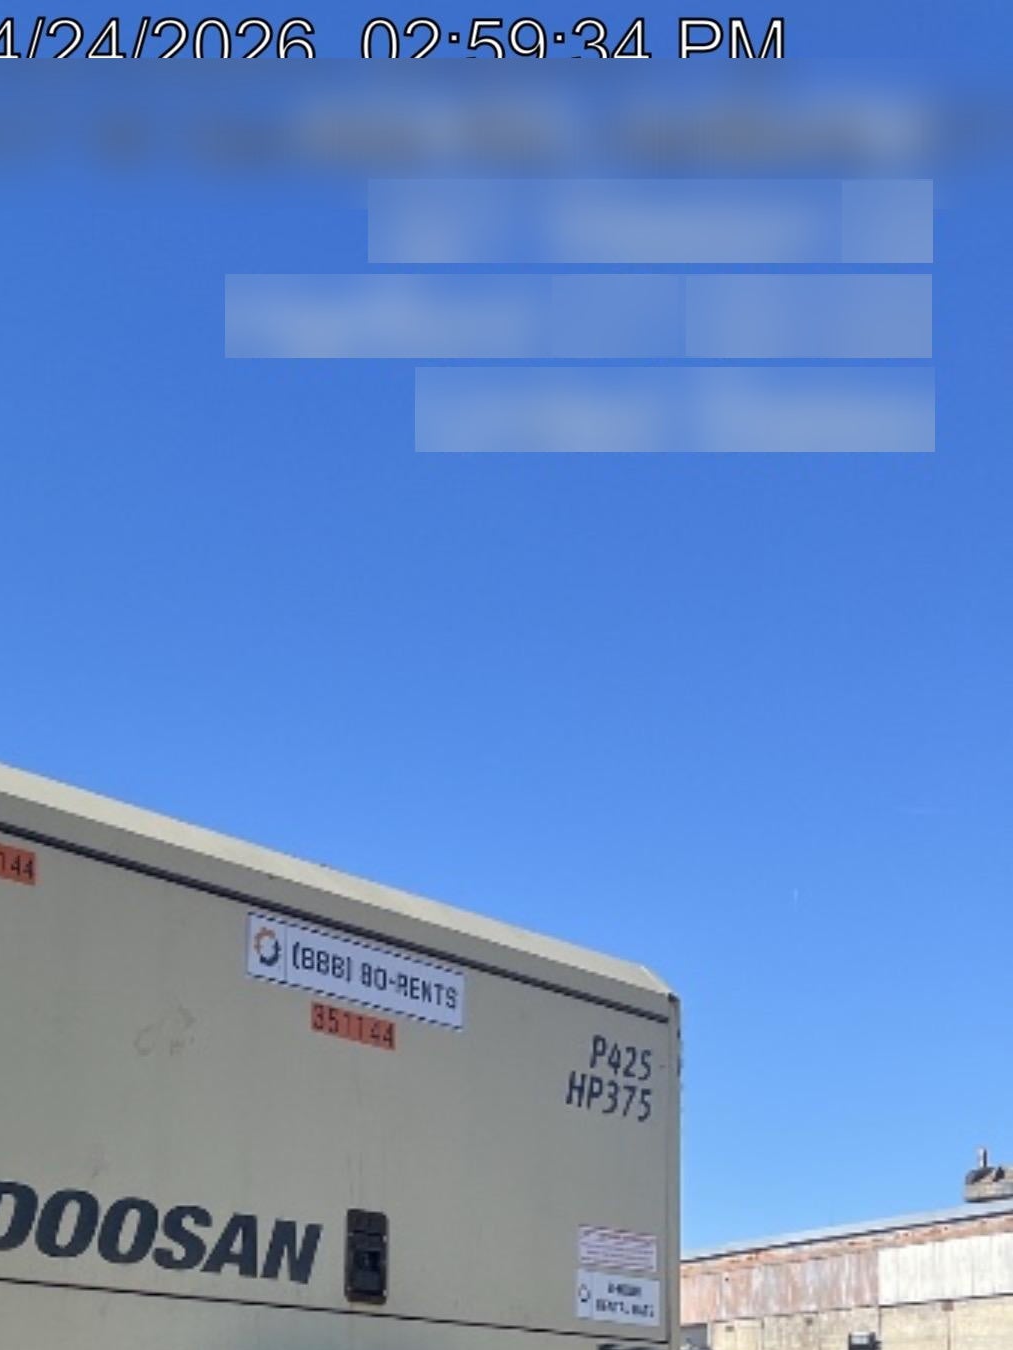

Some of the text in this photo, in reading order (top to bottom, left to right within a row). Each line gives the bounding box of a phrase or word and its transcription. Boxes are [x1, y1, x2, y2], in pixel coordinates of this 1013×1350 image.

[312, 1002, 395, 1049] 351144
[589, 1034, 652, 1081] P425
[565, 1069, 652, 1123] HP375
